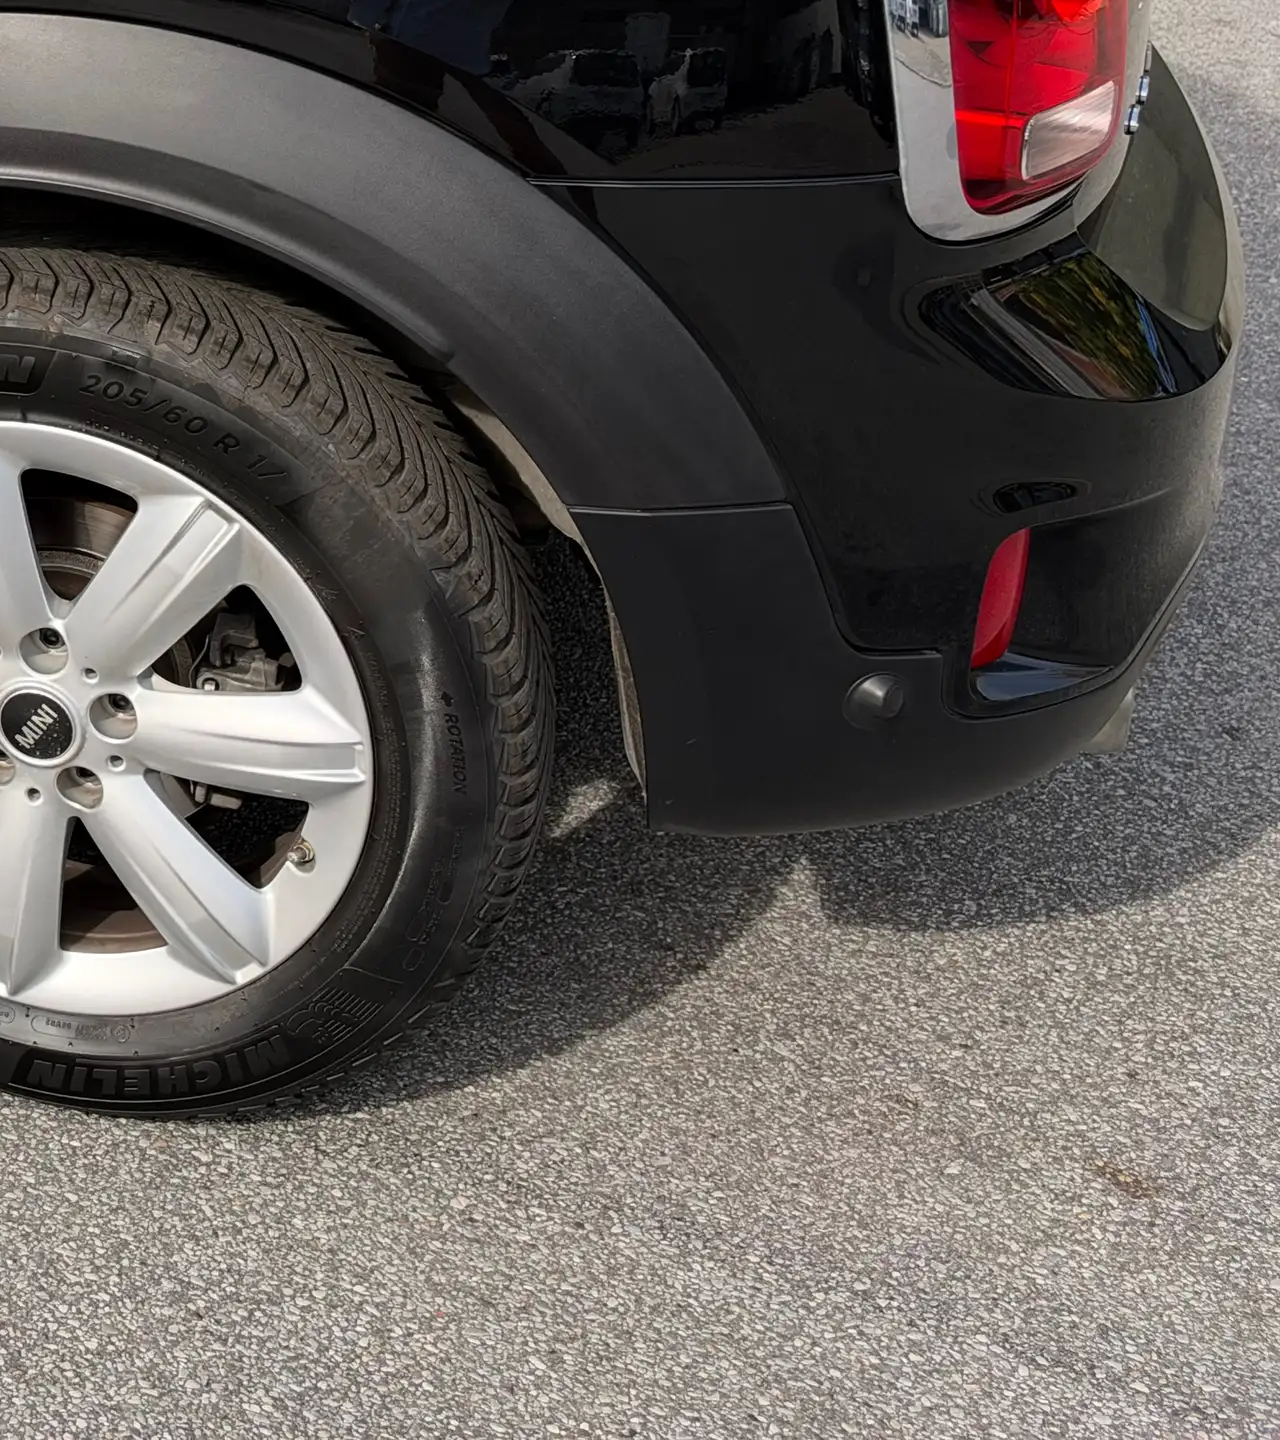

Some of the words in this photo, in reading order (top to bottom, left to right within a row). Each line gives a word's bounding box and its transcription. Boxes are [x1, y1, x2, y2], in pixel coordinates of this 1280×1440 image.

[78, 374, 209, 436] 205/60
[211, 432, 241, 455] R
[14, 703, 58, 749] MINI
[443, 712, 468, 797] ROTATION
[25, 1034, 290, 1097] MICHELIN
